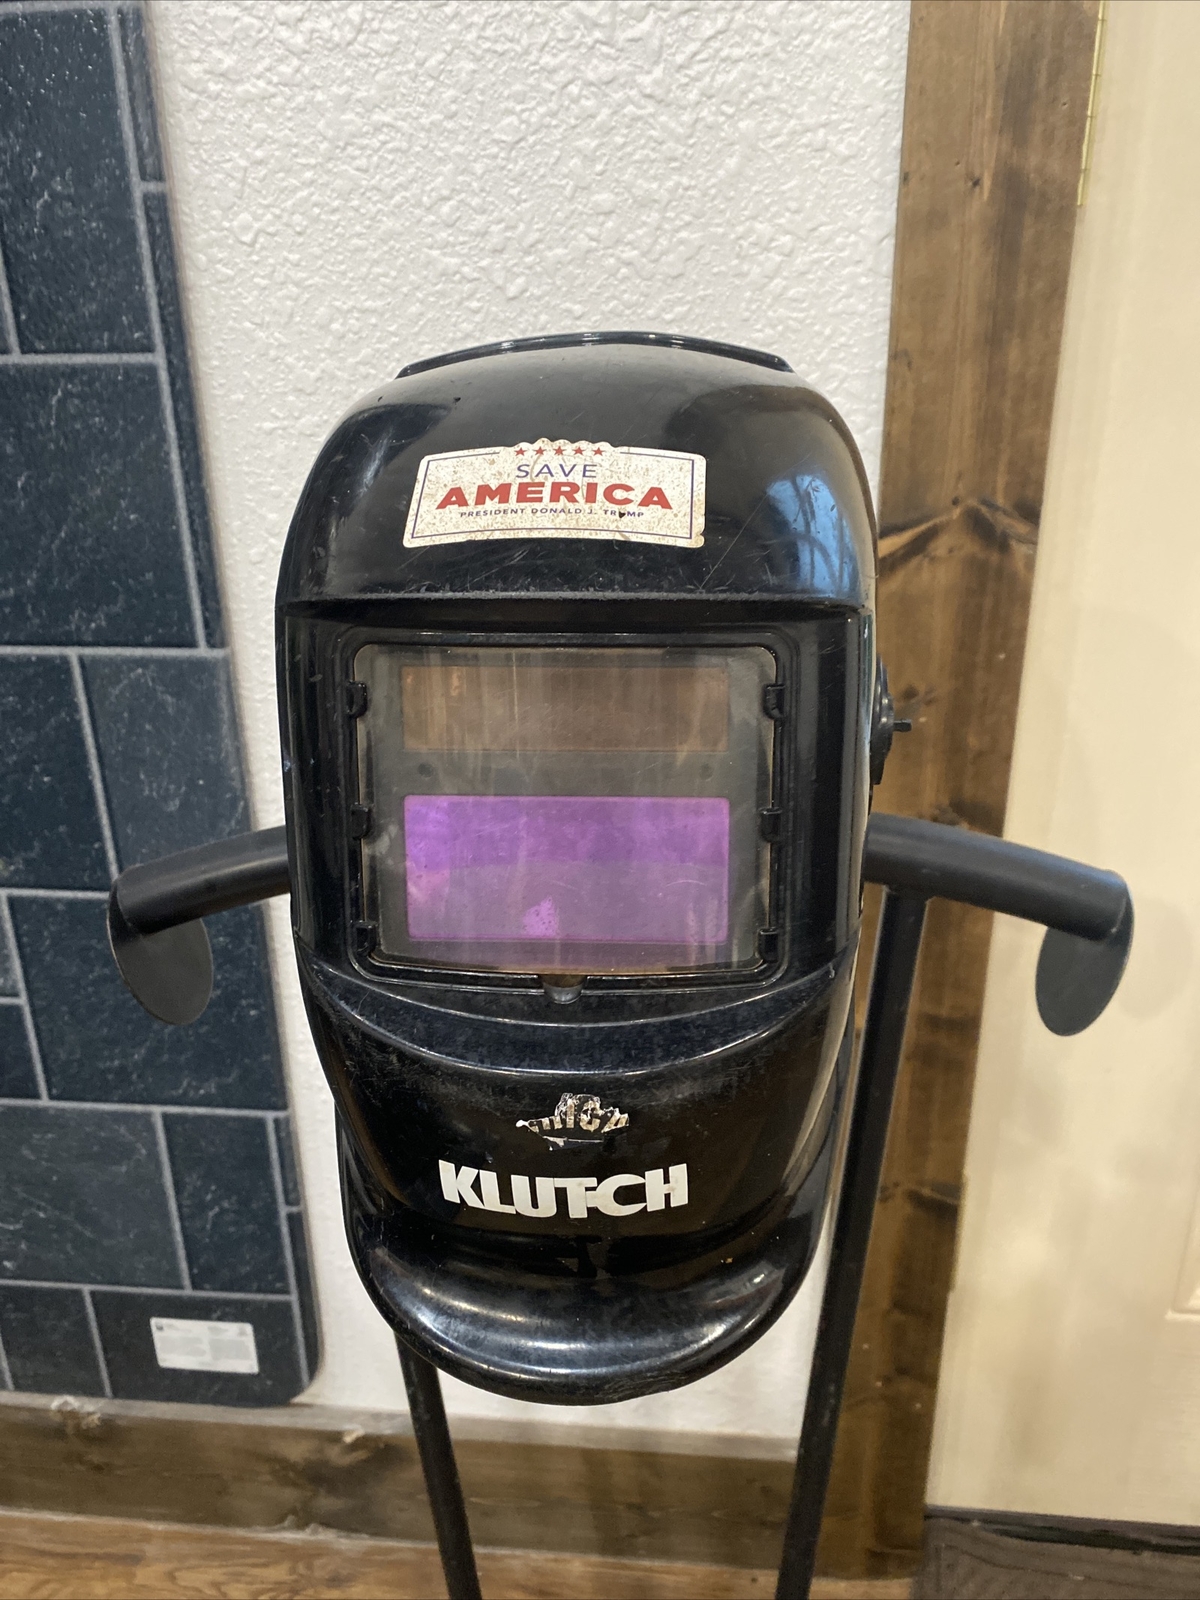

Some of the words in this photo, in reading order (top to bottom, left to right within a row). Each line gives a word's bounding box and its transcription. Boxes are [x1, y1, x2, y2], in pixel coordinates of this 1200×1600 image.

[515, 463, 598, 478] SAVE
[436, 481, 673, 510] AMERICA
[460, 508, 526, 518] PRESIDENT
[531, 507, 582, 515] DONALD
[603, 509, 644, 518] TRMP
[438, 1159, 688, 1219] KLUTCH
